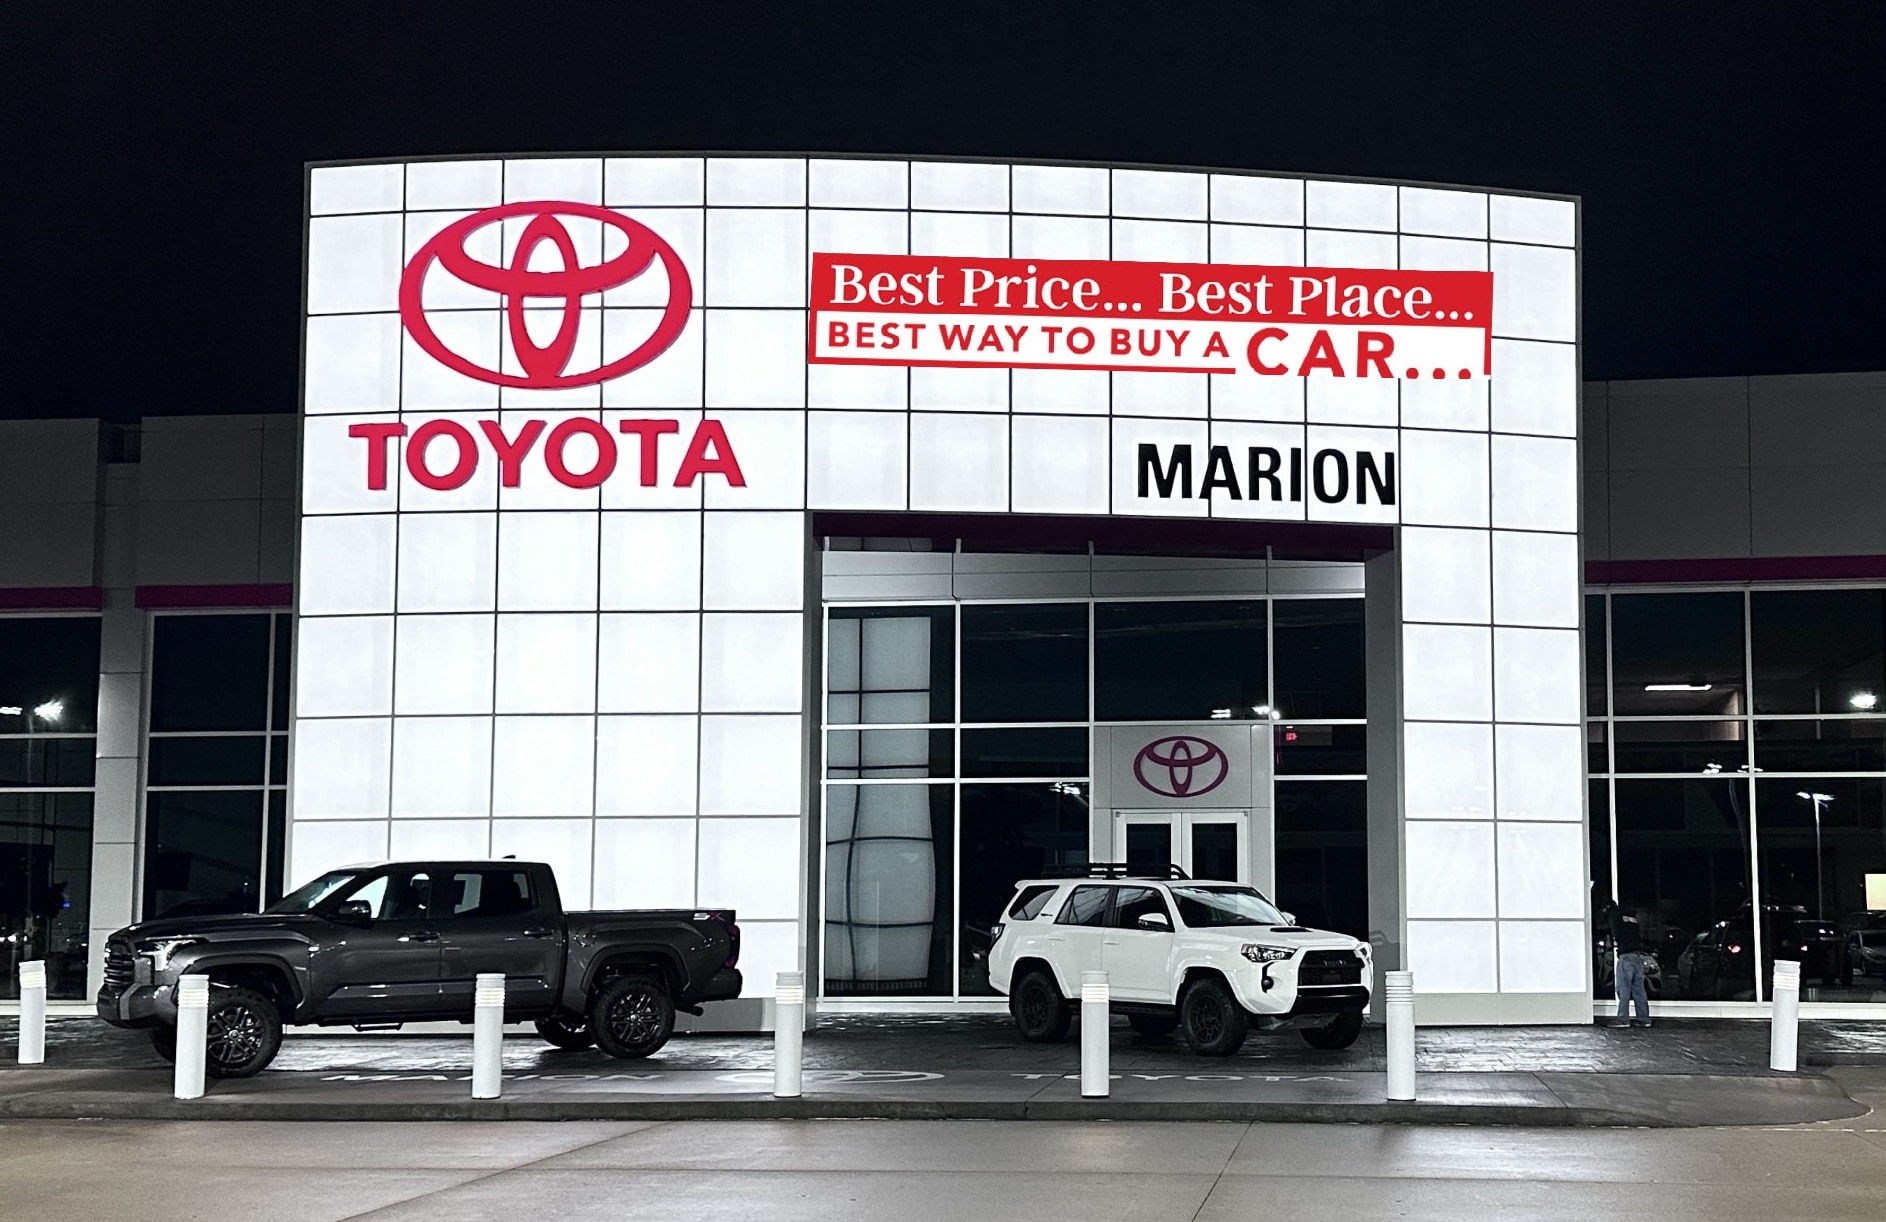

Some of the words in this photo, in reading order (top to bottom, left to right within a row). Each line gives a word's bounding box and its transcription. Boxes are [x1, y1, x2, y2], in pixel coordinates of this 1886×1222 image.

[829, 263, 945, 307] Best
[959, 264, 1143, 312] Price...
[1158, 272, 1274, 316] Best
[1287, 275, 1474, 321] Place...
[828, 321, 926, 350] BEST
[938, 324, 1029, 352] WAY
[1041, 326, 1095, 355] TO
[1110, 327, 1191, 357] BUY
[1202, 331, 1230, 358] A
[1246, 326, 1472, 380] CAR...
[348, 416, 748, 491] TOYOTA
[1137, 442, 1396, 506] MARION
